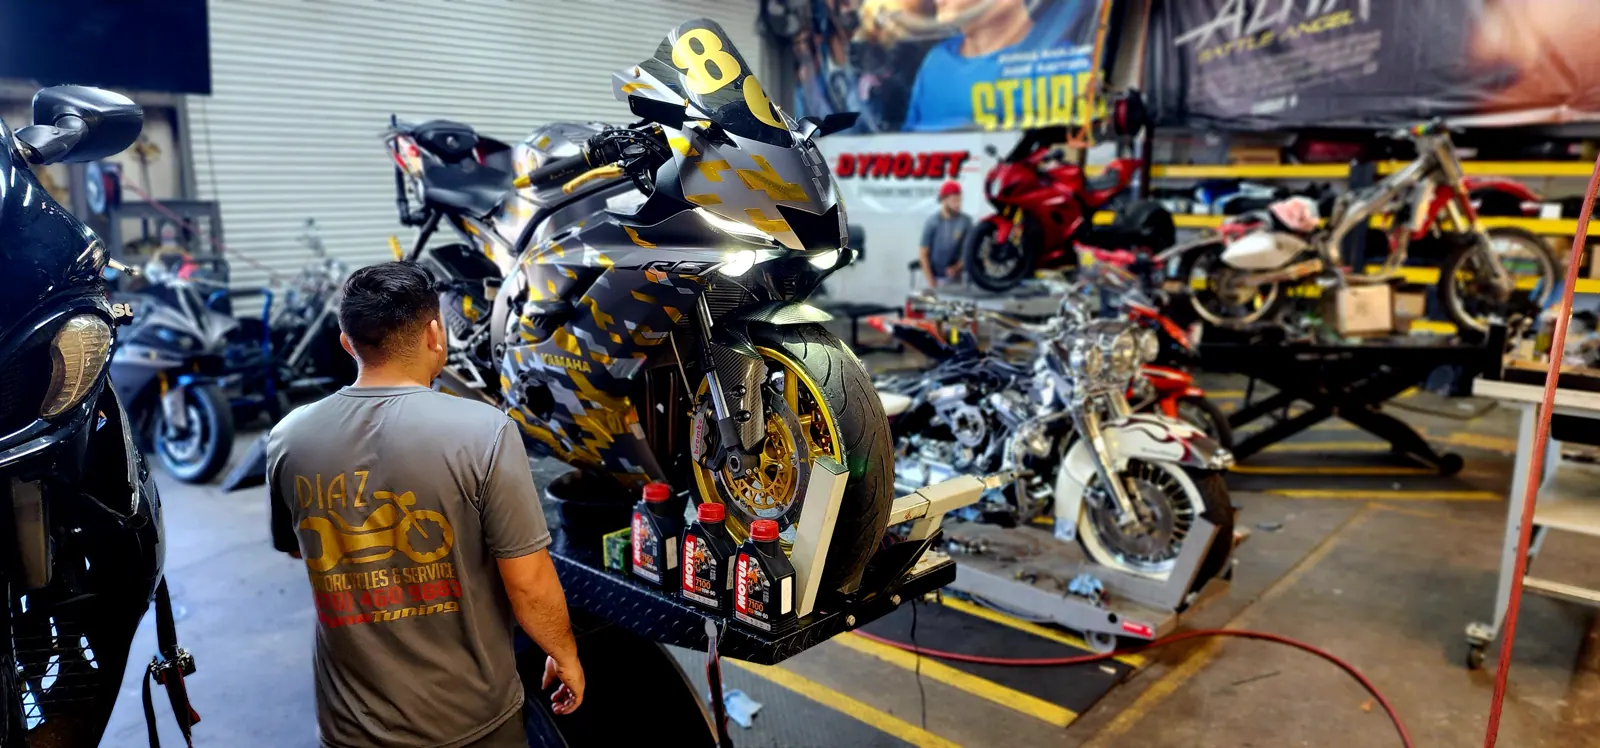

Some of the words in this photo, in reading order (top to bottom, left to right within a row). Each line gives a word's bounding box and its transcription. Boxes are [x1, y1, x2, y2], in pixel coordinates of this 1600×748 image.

[836, 150, 969, 180] DYNOJET
[540, 352, 592, 374] YAMAHA
[295, 470, 371, 509] DIAZ
[633, 518, 642, 564] MOTUL
[402, 562, 456, 584] SERVICE
[685, 541, 695, 589] MOTUL
[695, 578, 711, 590] 7100
[737, 559, 747, 611] MOTUL
[748, 599, 764, 612] 7100
